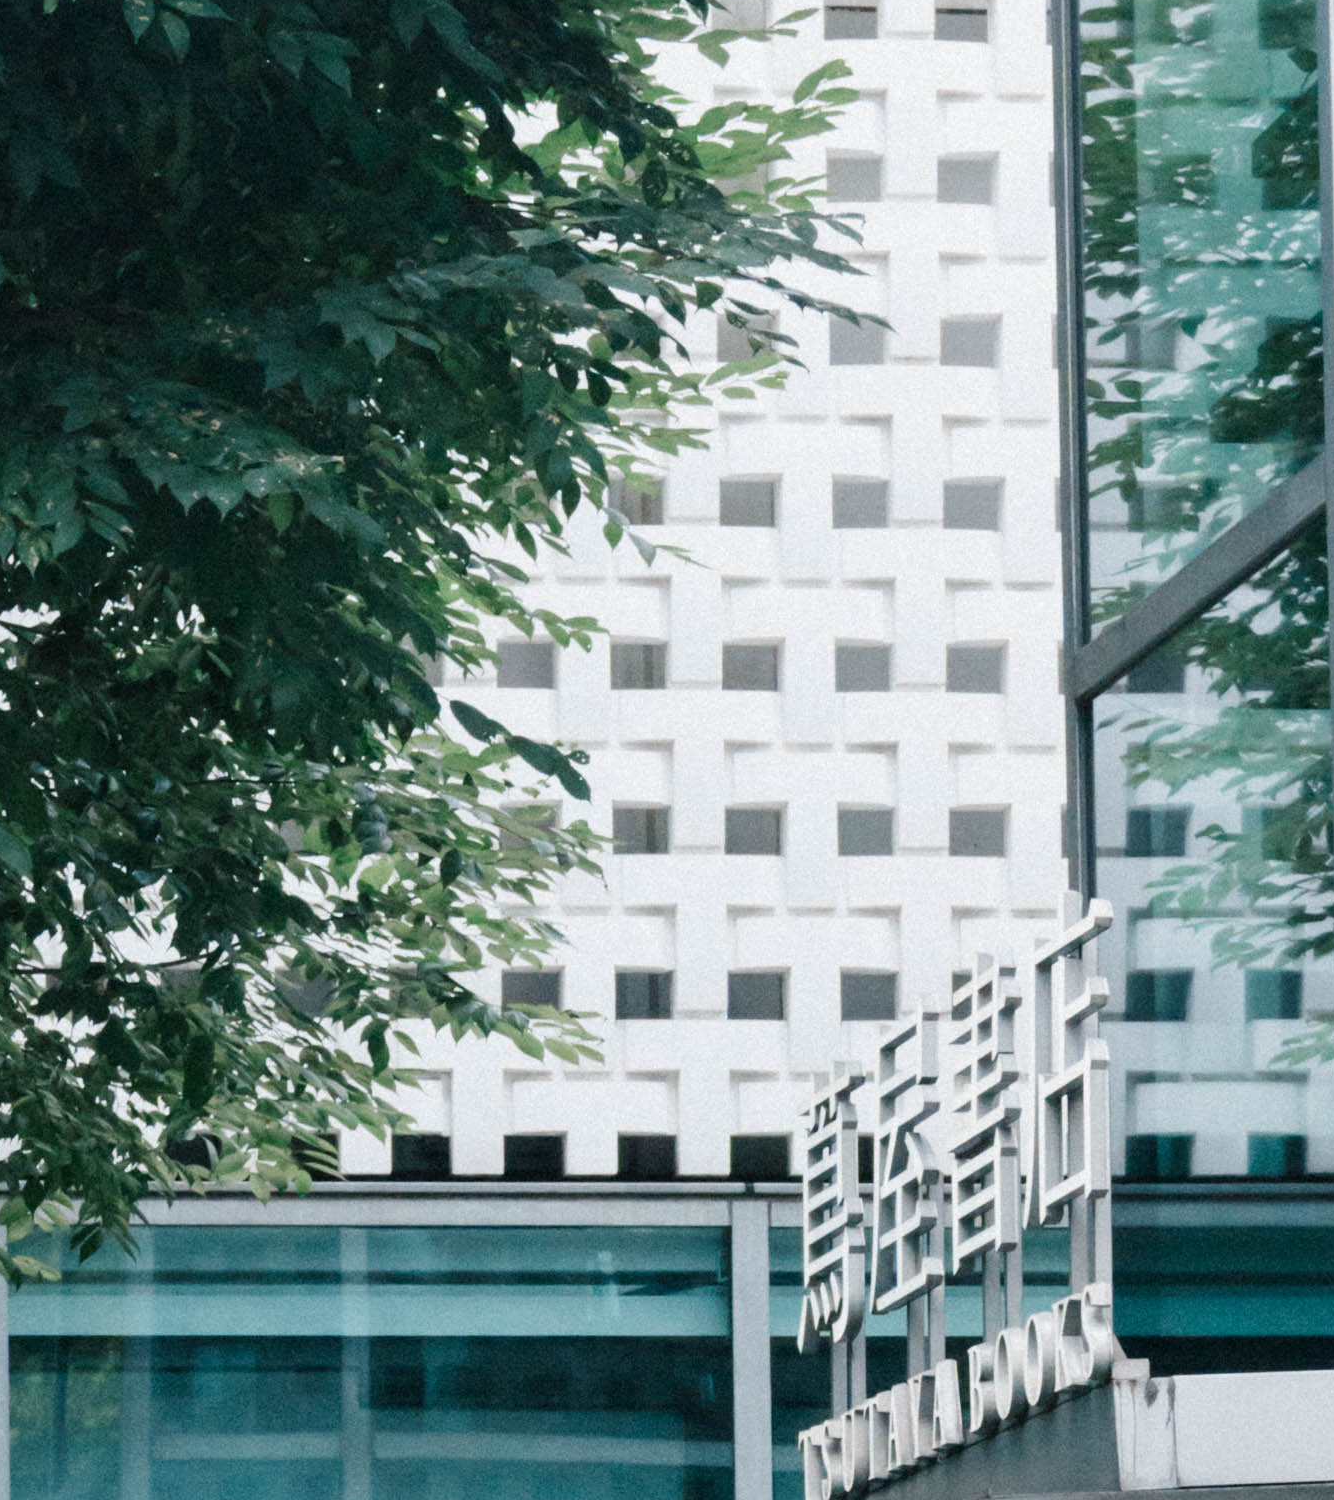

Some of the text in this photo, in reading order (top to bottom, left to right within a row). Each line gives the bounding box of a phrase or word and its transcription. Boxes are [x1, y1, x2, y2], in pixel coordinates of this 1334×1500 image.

[798, 891, 1113, 1356] 蔦屋書店
[968, 1283, 1114, 1433] BOOKS
